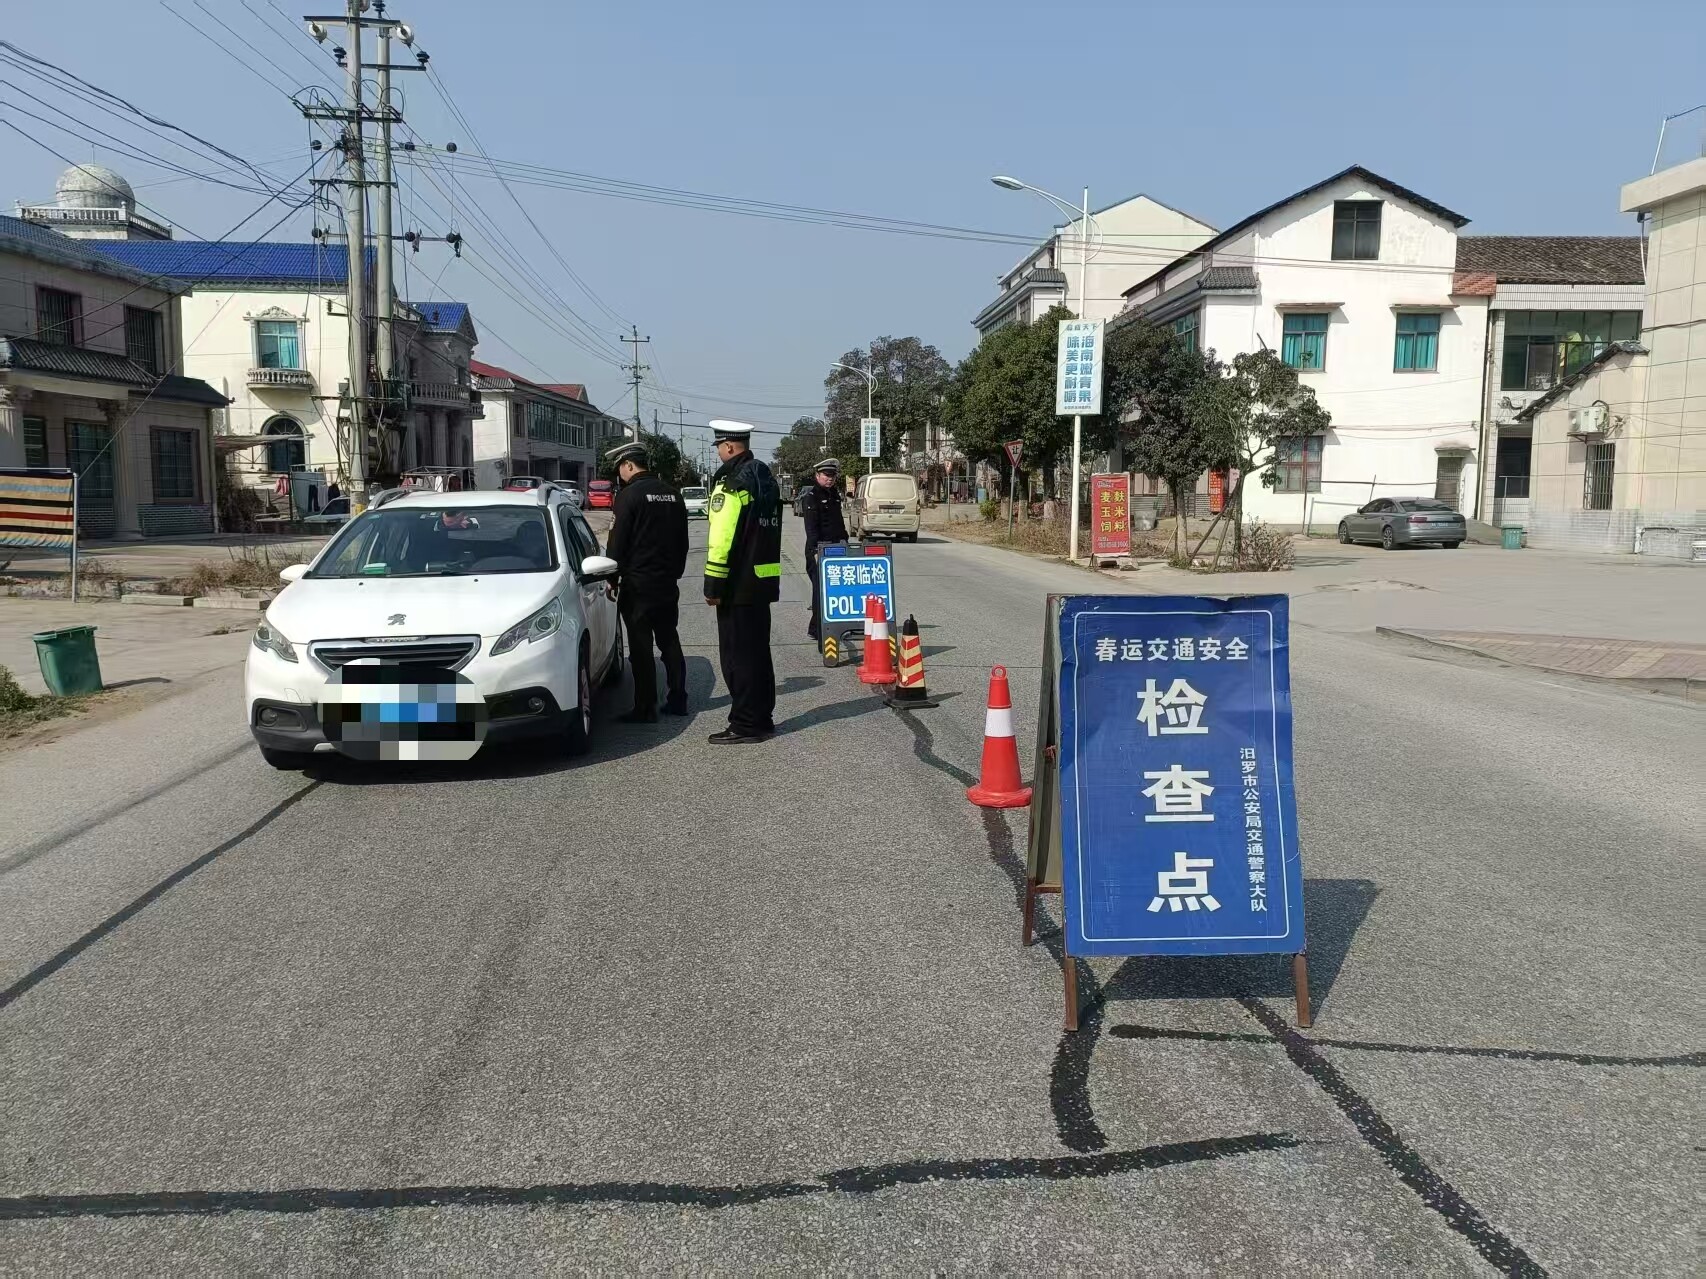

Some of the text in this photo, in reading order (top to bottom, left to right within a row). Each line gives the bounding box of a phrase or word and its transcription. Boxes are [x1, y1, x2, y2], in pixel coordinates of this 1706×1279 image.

[1064, 336, 1080, 403] 味美更耐嚼
[1078, 335, 1094, 403] 海南嫩青果
[827, 563, 886, 586] 警察临检
[1095, 637, 1249, 662] 春运交通安全
[1136, 678, 1222, 913] 检查点
[1240, 747, 1268, 912] 汨罗市公安局交通警察大队
